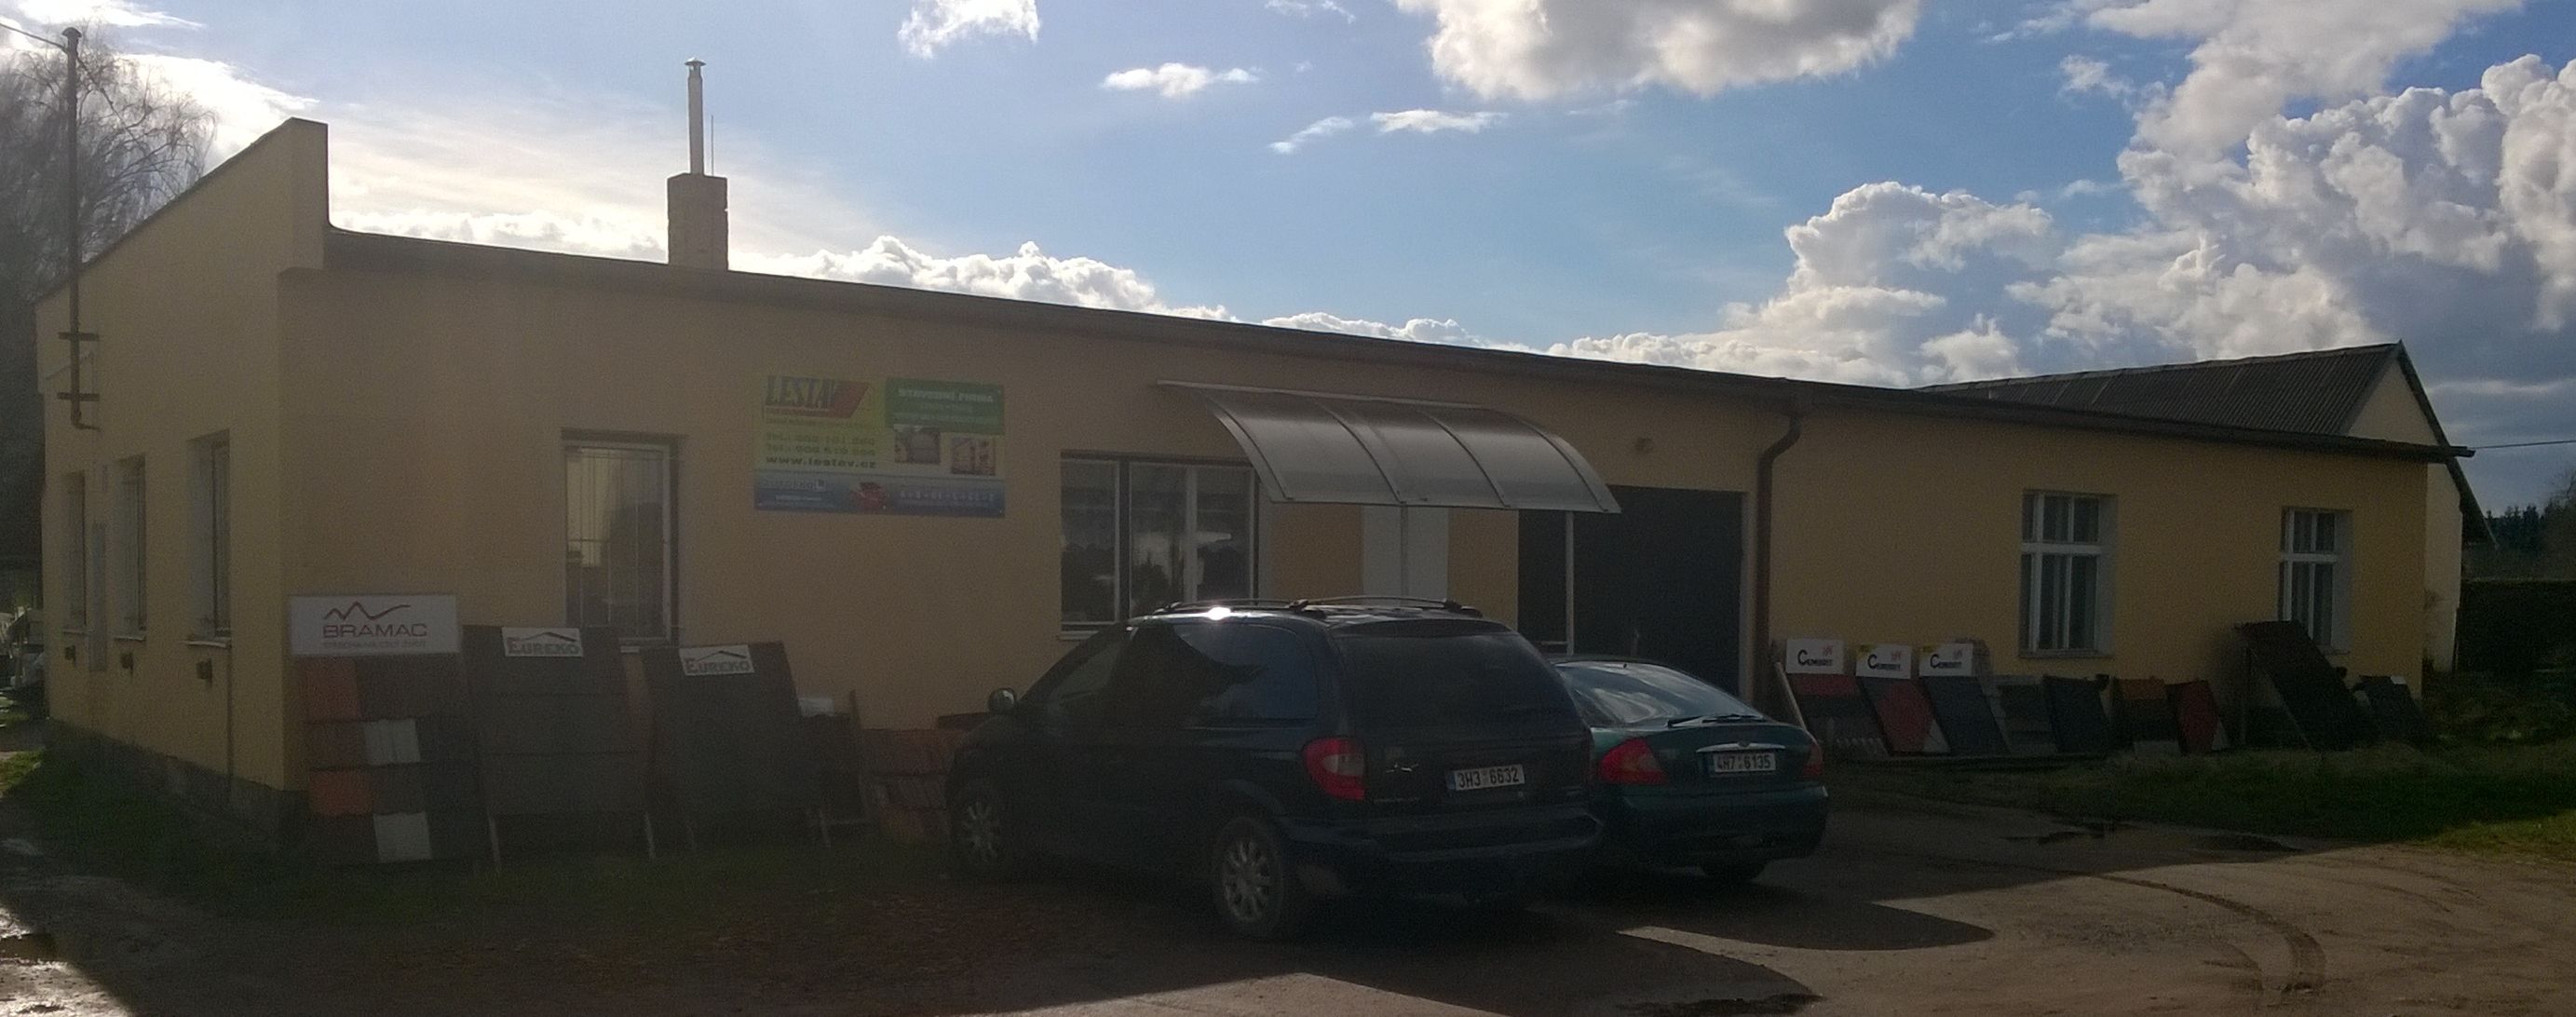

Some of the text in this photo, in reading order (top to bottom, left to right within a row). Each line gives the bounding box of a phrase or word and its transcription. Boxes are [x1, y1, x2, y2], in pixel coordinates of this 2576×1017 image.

[322, 623, 427, 639] BRAMAC
[685, 657, 751, 673] EUREKO
[1743, 755, 1771, 769] 6135
[1457, 766, 1520, 788] 3H3 6632
